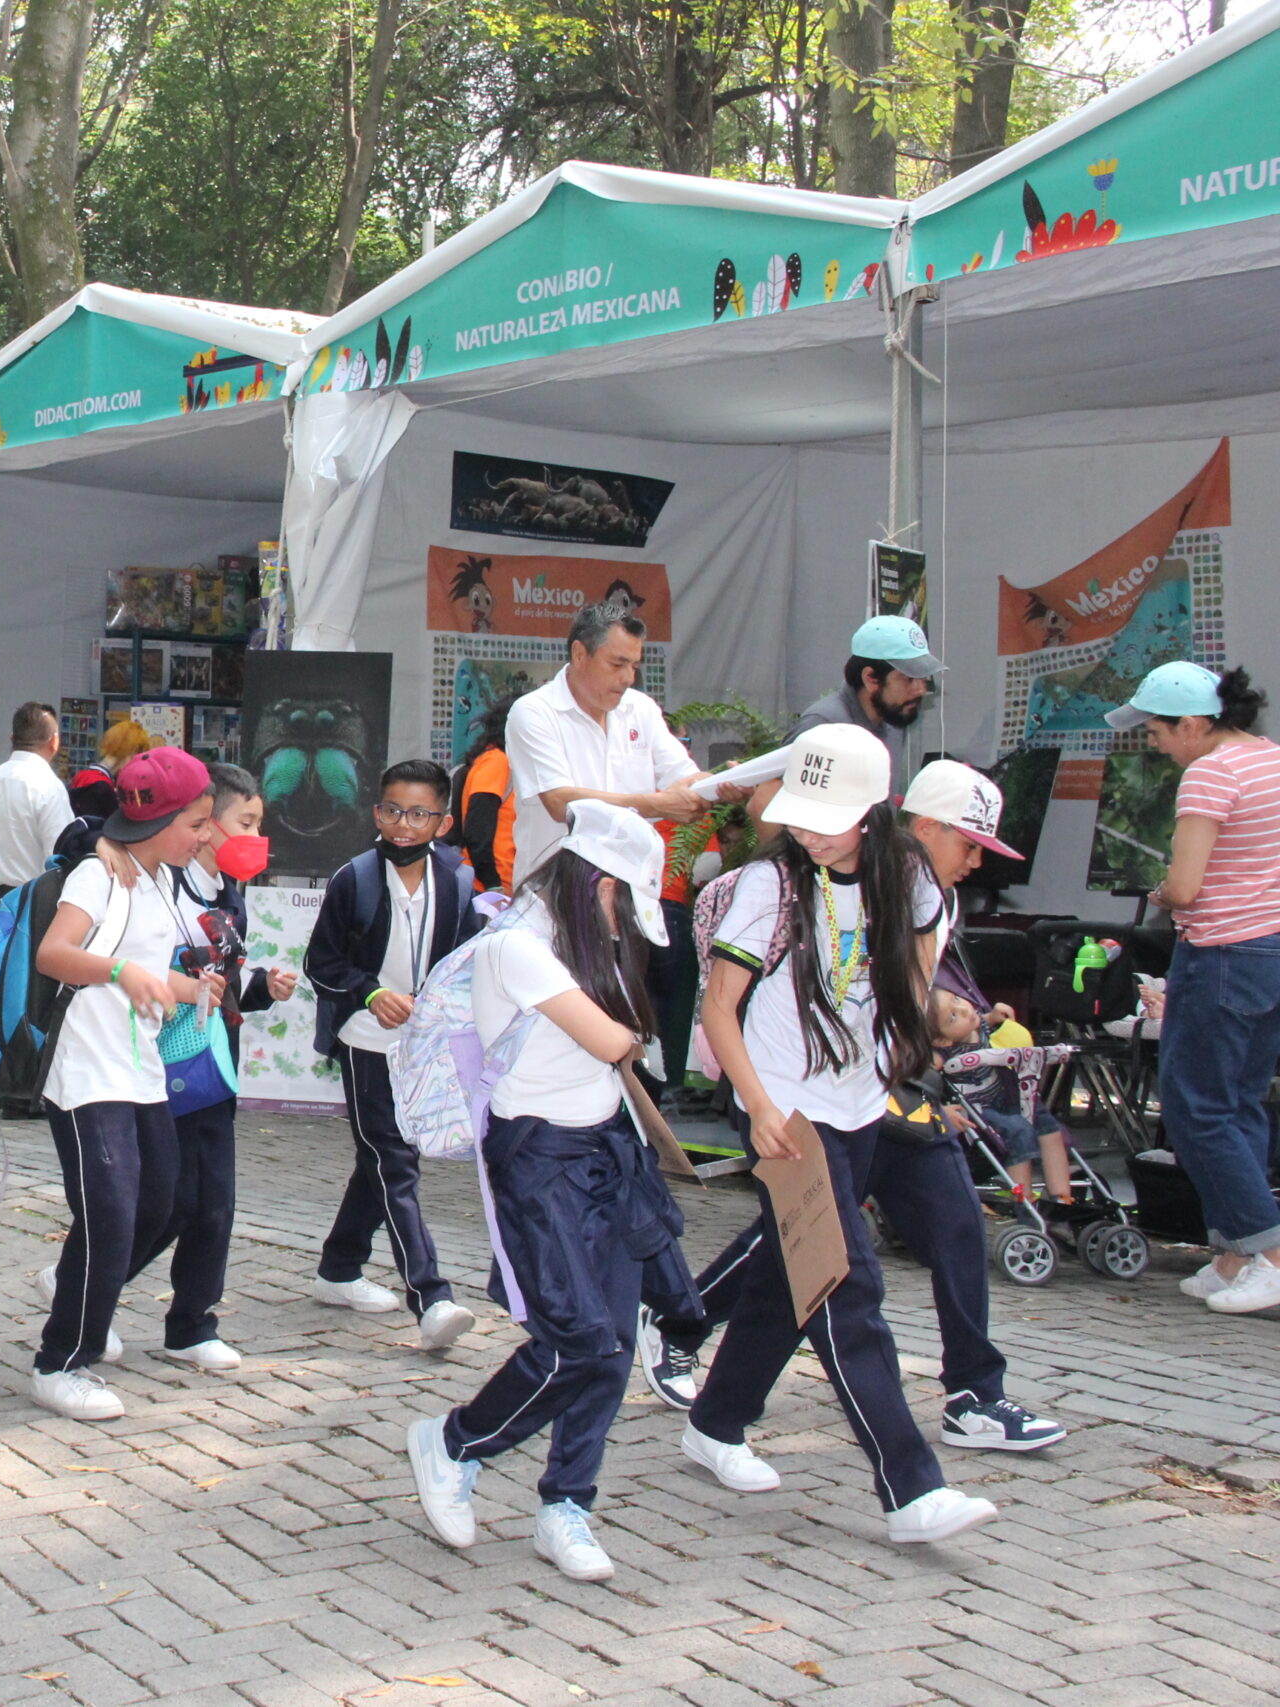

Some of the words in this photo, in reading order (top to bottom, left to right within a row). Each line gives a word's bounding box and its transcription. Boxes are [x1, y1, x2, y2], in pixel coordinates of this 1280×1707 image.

[455, 308, 568, 352] NATURALEZA
[571, 286, 681, 326] MEXICANA
[511, 574, 585, 607] México
[1064, 555, 1159, 617] México
[804, 752, 835, 772] UNI
[800, 769, 831, 789] QUE
